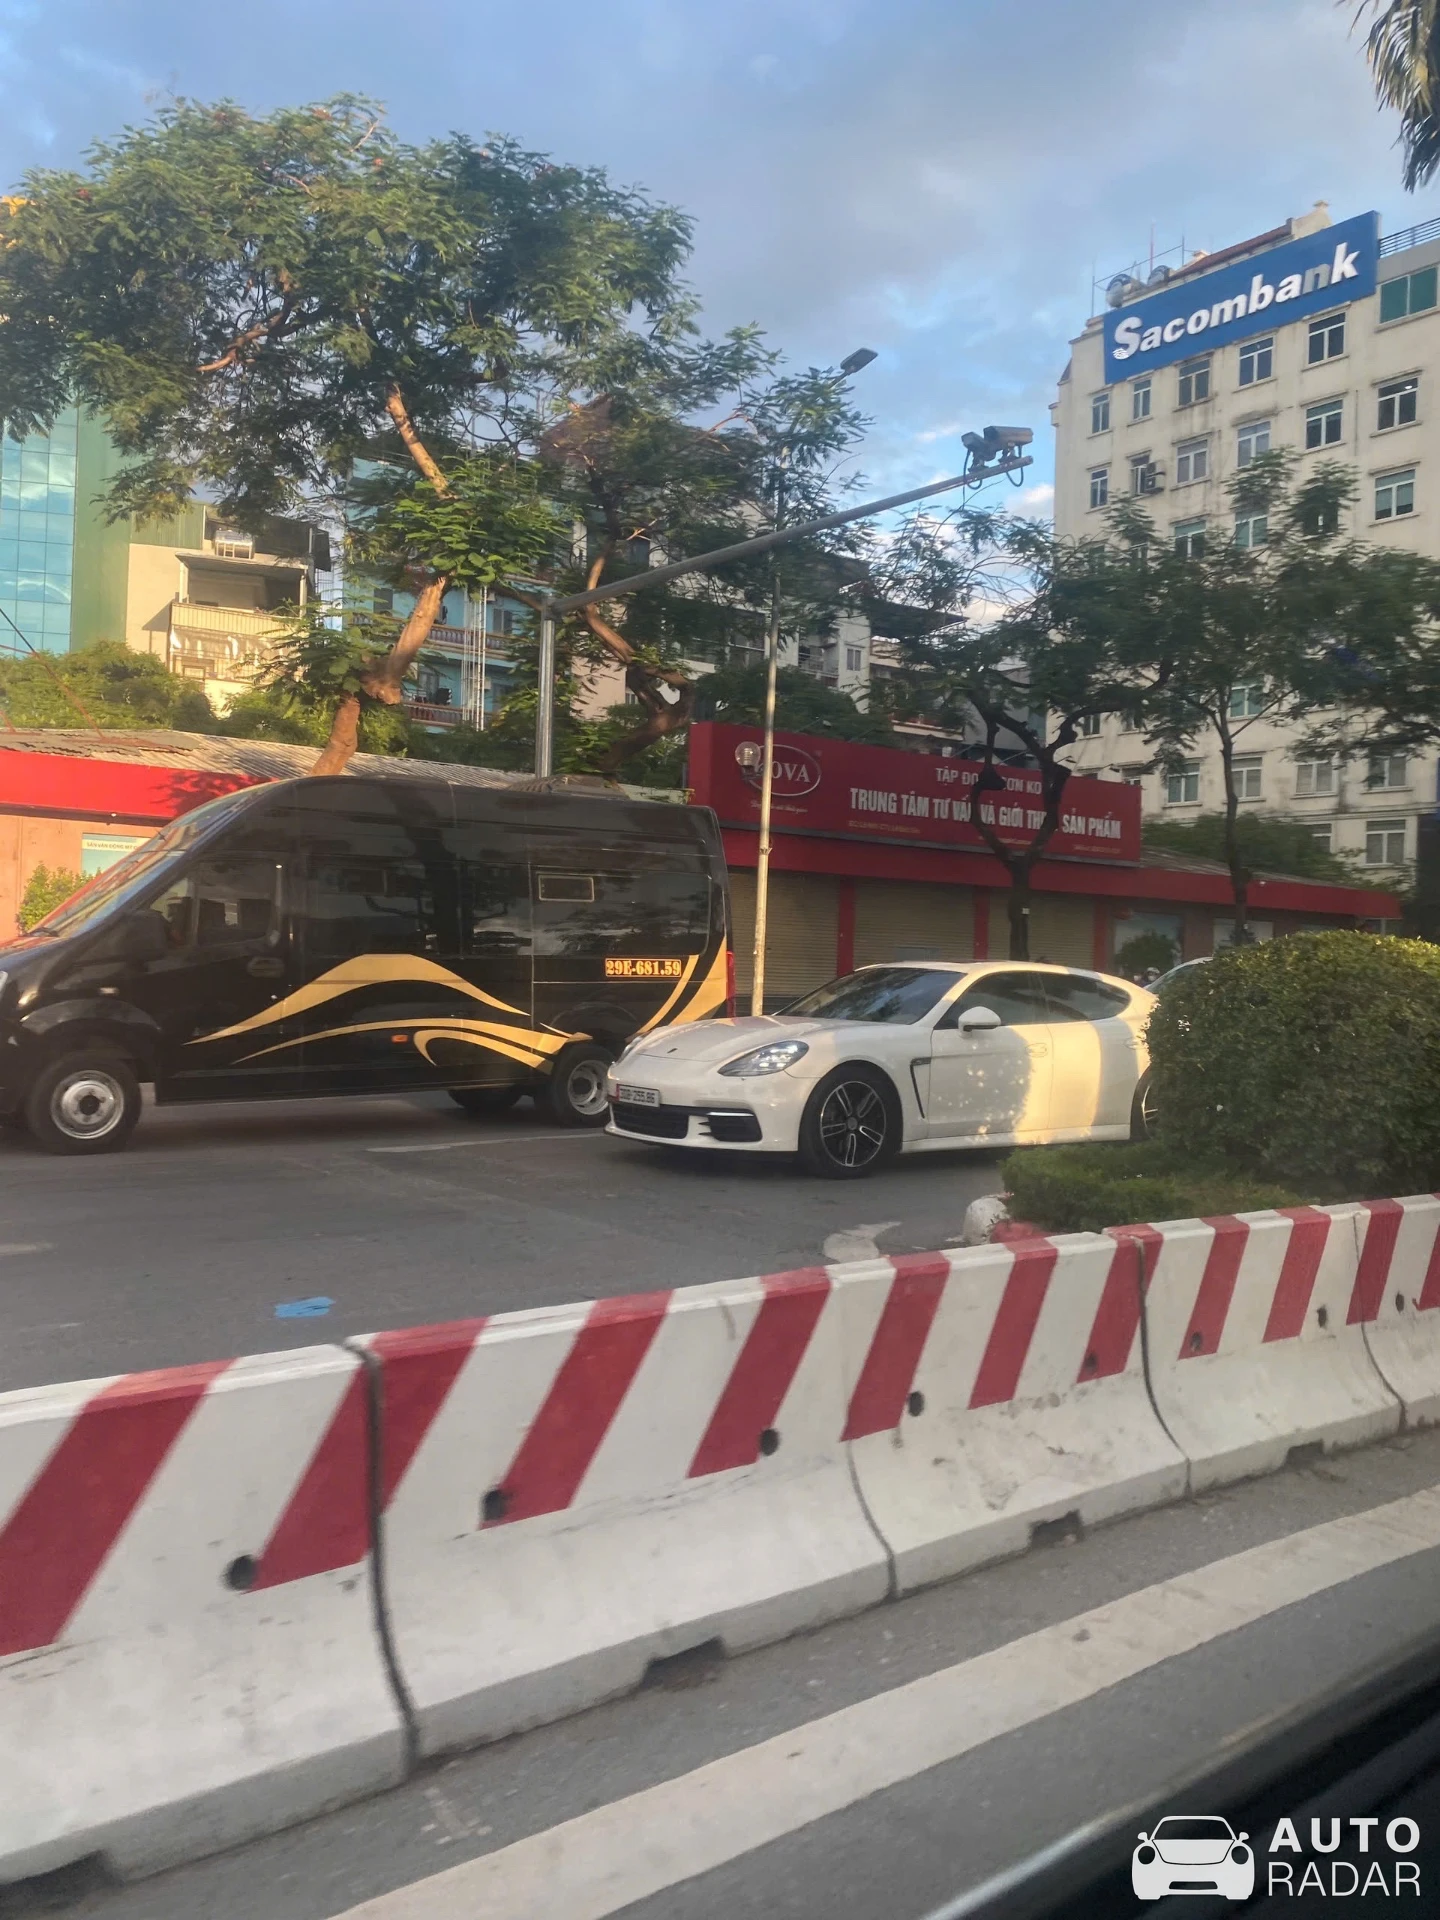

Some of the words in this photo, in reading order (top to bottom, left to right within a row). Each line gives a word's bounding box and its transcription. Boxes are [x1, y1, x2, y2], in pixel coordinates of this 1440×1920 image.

[1114, 242, 1360, 358] Sacombank
[935, 765, 958, 786] TẬP
[961, 772, 979, 786] ĐO
[1001, 776, 1024, 792] ƠN
[850, 787, 898, 814] TRUNG
[901, 791, 930, 818] TÂM
[932, 797, 951, 820] TƯ
[979, 799, 996, 825] VÀ
[998, 802, 1024, 828] GIỚI
[1062, 807, 1086, 835] SẢN
[1088, 811, 1122, 839] PHẨM
[606, 960, 681, 976] 29E-681.59
